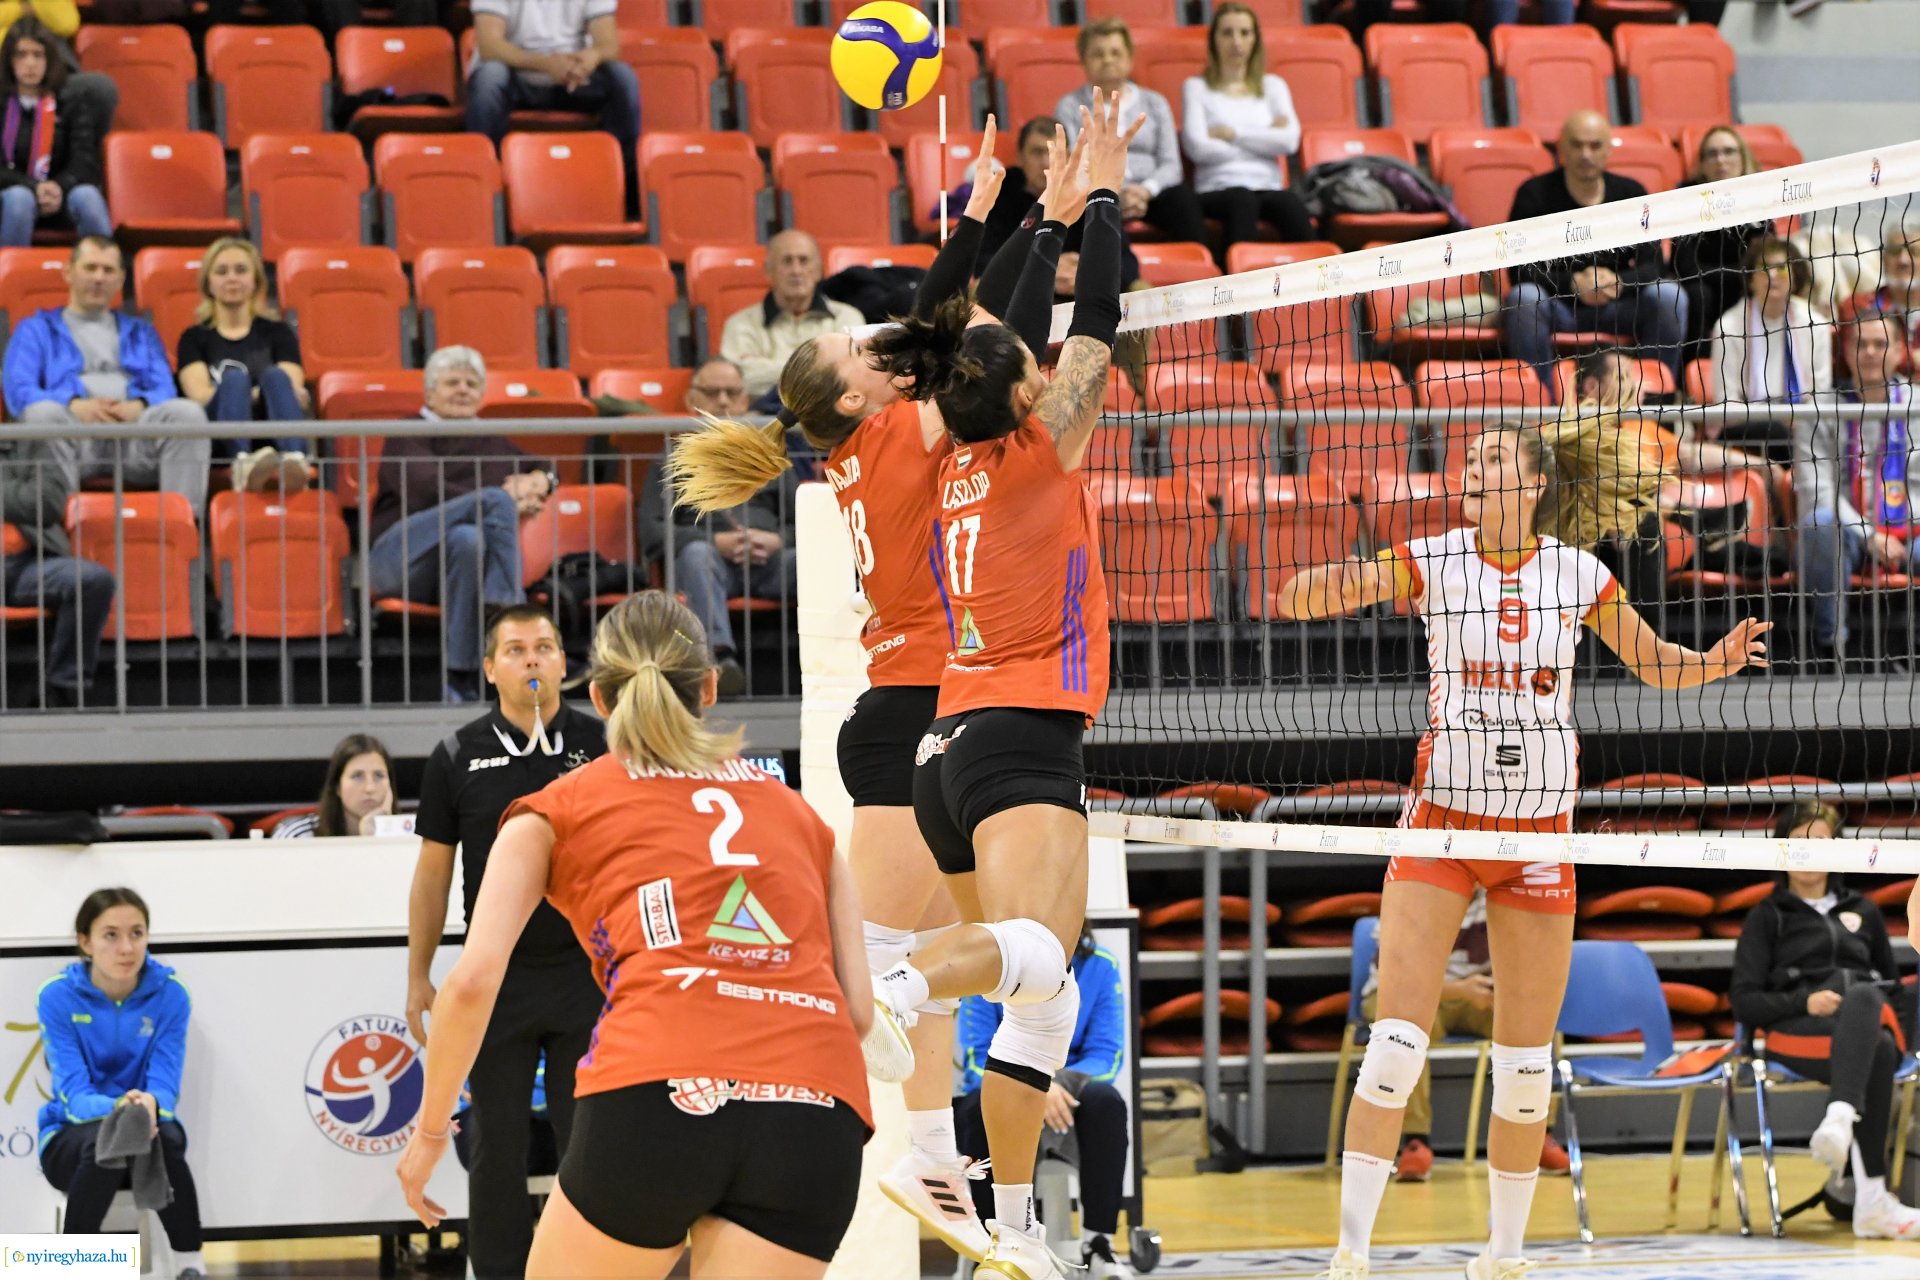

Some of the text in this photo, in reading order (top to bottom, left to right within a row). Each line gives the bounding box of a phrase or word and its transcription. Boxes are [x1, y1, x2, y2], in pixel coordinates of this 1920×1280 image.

[945, 514, 981, 595] 17
[1497, 597, 1529, 643] 9
[1460, 660, 1526, 692] HELL
[468, 755, 510, 772] Zeus
[1484, 768, 1528, 779] SEAT
[691, 786, 761, 867] 2
[1702, 842, 1728, 862] FATUM
[1510, 886, 1571, 899] SEAT
[649, 884, 671, 945] STRABAG
[771, 947, 790, 962] 21
[717, 980, 837, 1014] BESTRONG
[338, 1018, 407, 1041] FATUM
